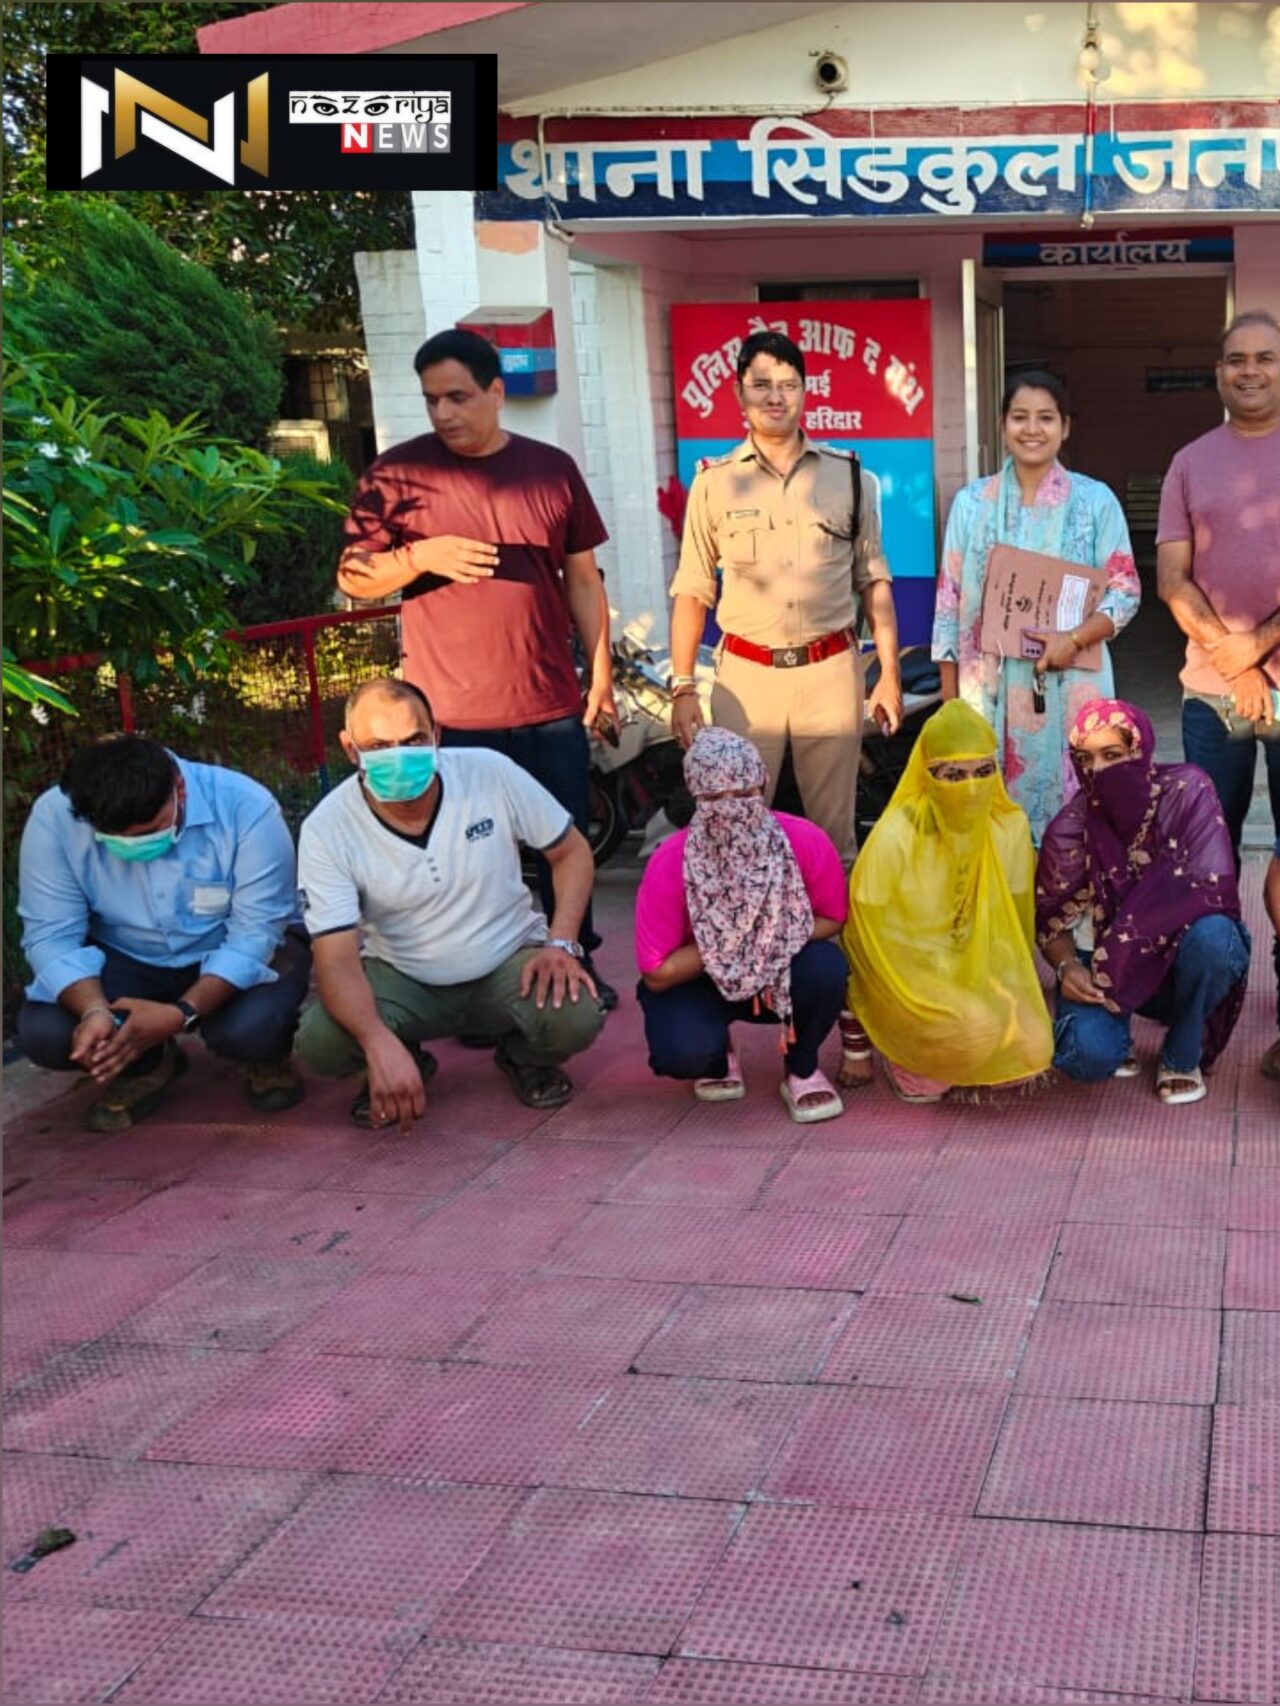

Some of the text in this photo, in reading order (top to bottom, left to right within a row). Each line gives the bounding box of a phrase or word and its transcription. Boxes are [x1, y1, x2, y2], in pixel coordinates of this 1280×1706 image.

[504, 139, 711, 202] थाना
[738, 117, 1084, 214] सिडकुल
[1039, 231, 1192, 265] कार्यालय
